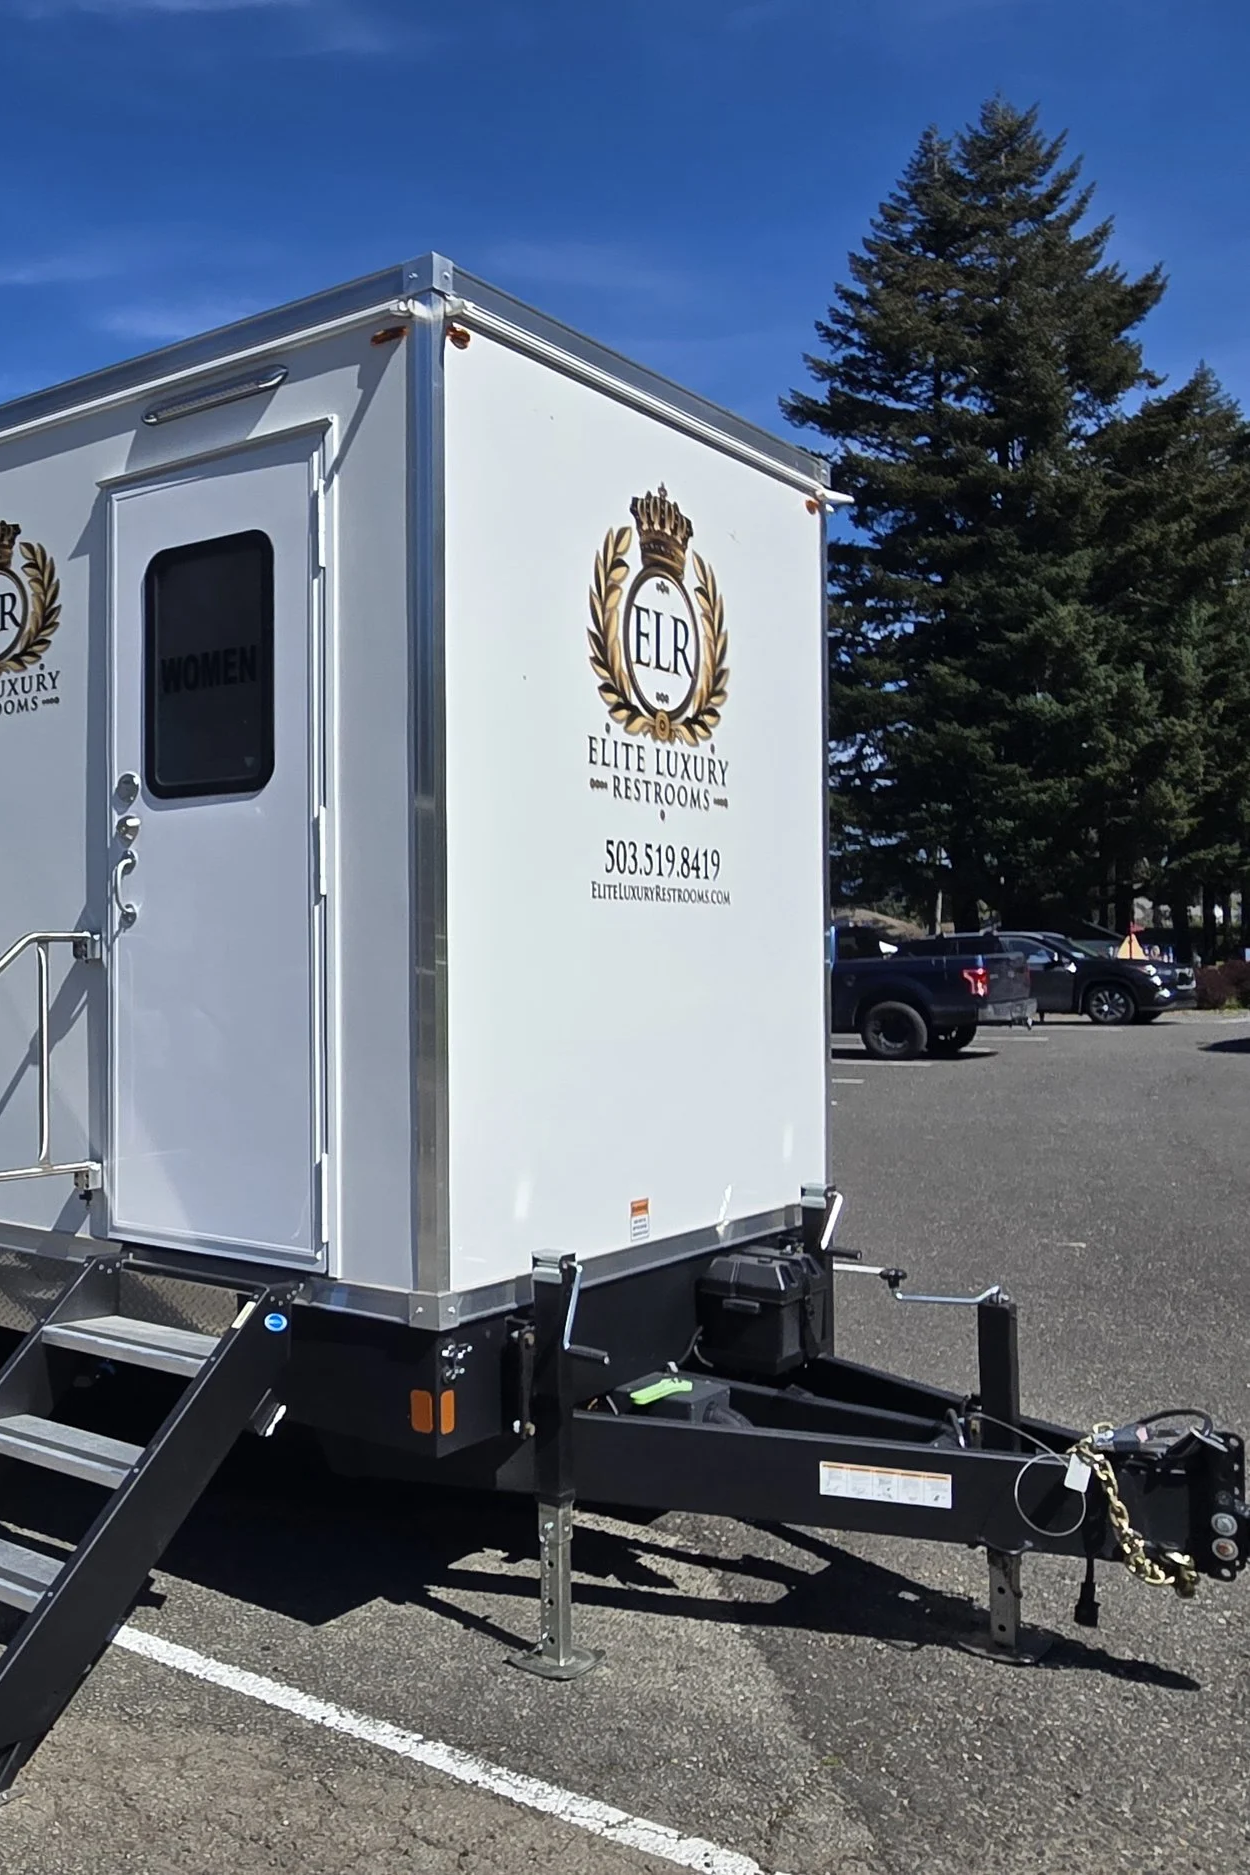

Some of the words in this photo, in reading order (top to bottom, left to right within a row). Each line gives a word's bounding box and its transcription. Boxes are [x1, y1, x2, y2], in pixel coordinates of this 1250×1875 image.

[632, 604, 694, 679] ELR
[161, 645, 257, 695] WOMEN
[588, 734, 646, 774] ELITE
[655, 747, 729, 788] LUXURY
[612, 775, 710, 812] RESTROOMS
[605, 839, 721, 882] 503.519.8419
